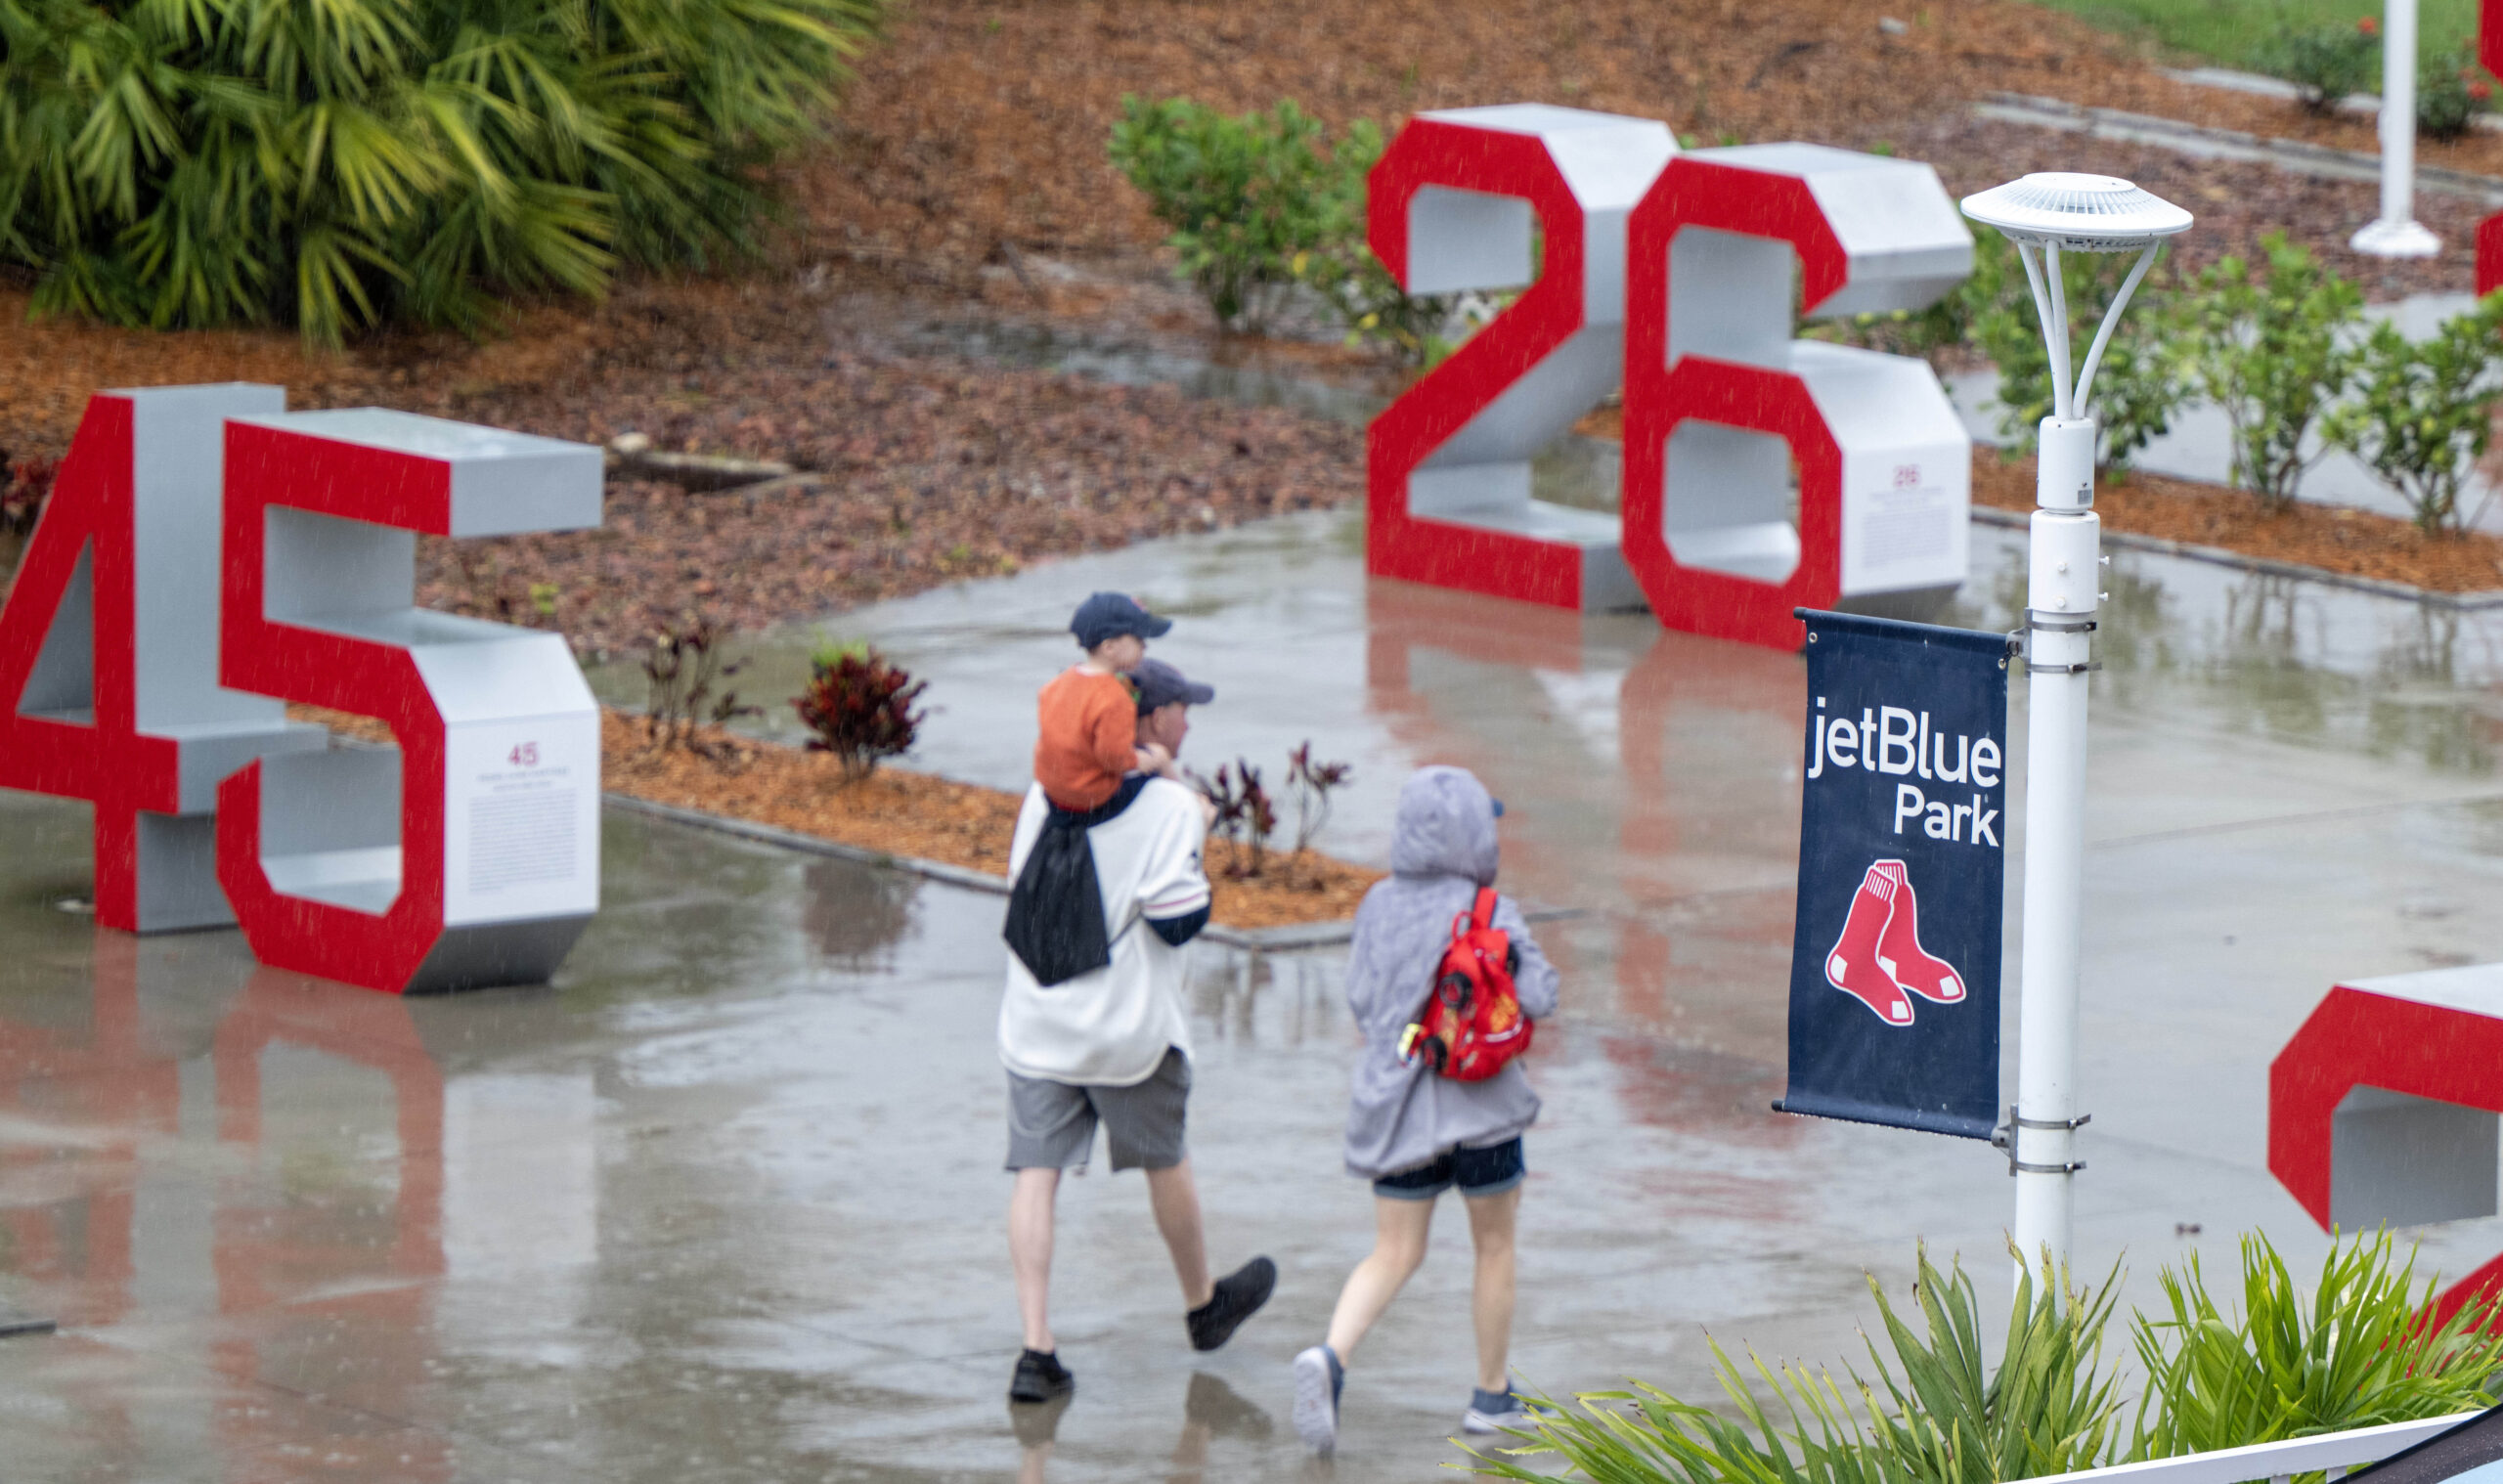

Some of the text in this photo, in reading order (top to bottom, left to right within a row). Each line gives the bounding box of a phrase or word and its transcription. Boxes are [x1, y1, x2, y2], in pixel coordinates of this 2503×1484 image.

[1365, 117, 1849, 654] 26
[0, 392, 451, 995] 45
[507, 740, 540, 766] 45
[1808, 697, 2002, 788] jetBlue
[1894, 783, 2000, 848] Park
